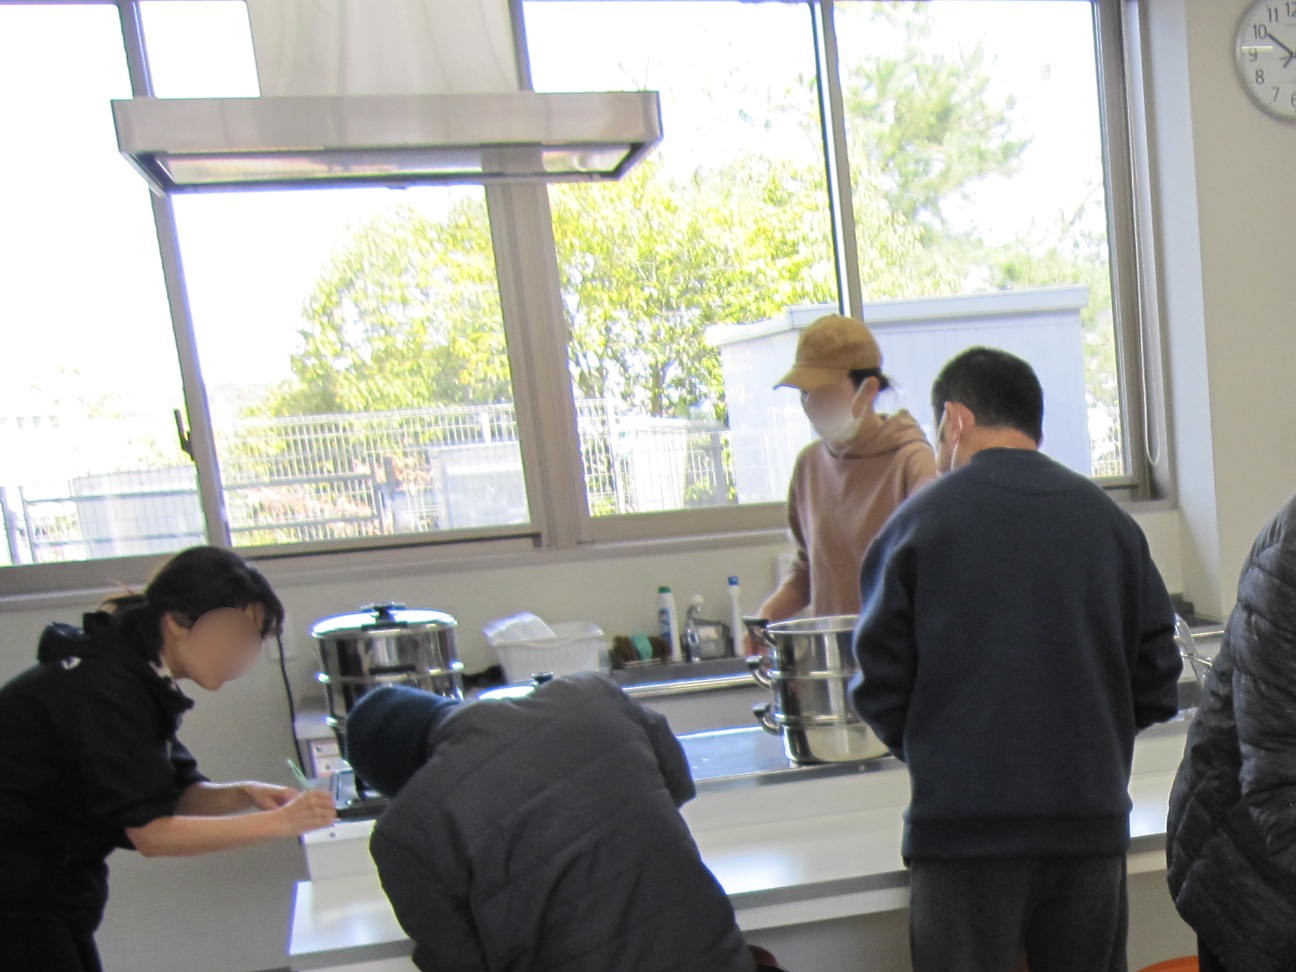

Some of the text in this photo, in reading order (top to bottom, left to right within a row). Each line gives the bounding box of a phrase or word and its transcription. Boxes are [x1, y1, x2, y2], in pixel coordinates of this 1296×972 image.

[1267, 7, 1279, 23] 11
[1253, 24, 1267, 39] 10
[1248, 48, 1258, 62] 9
[1255, 69, 1265, 85] 8
[1272, 87, 1280, 102] 7
